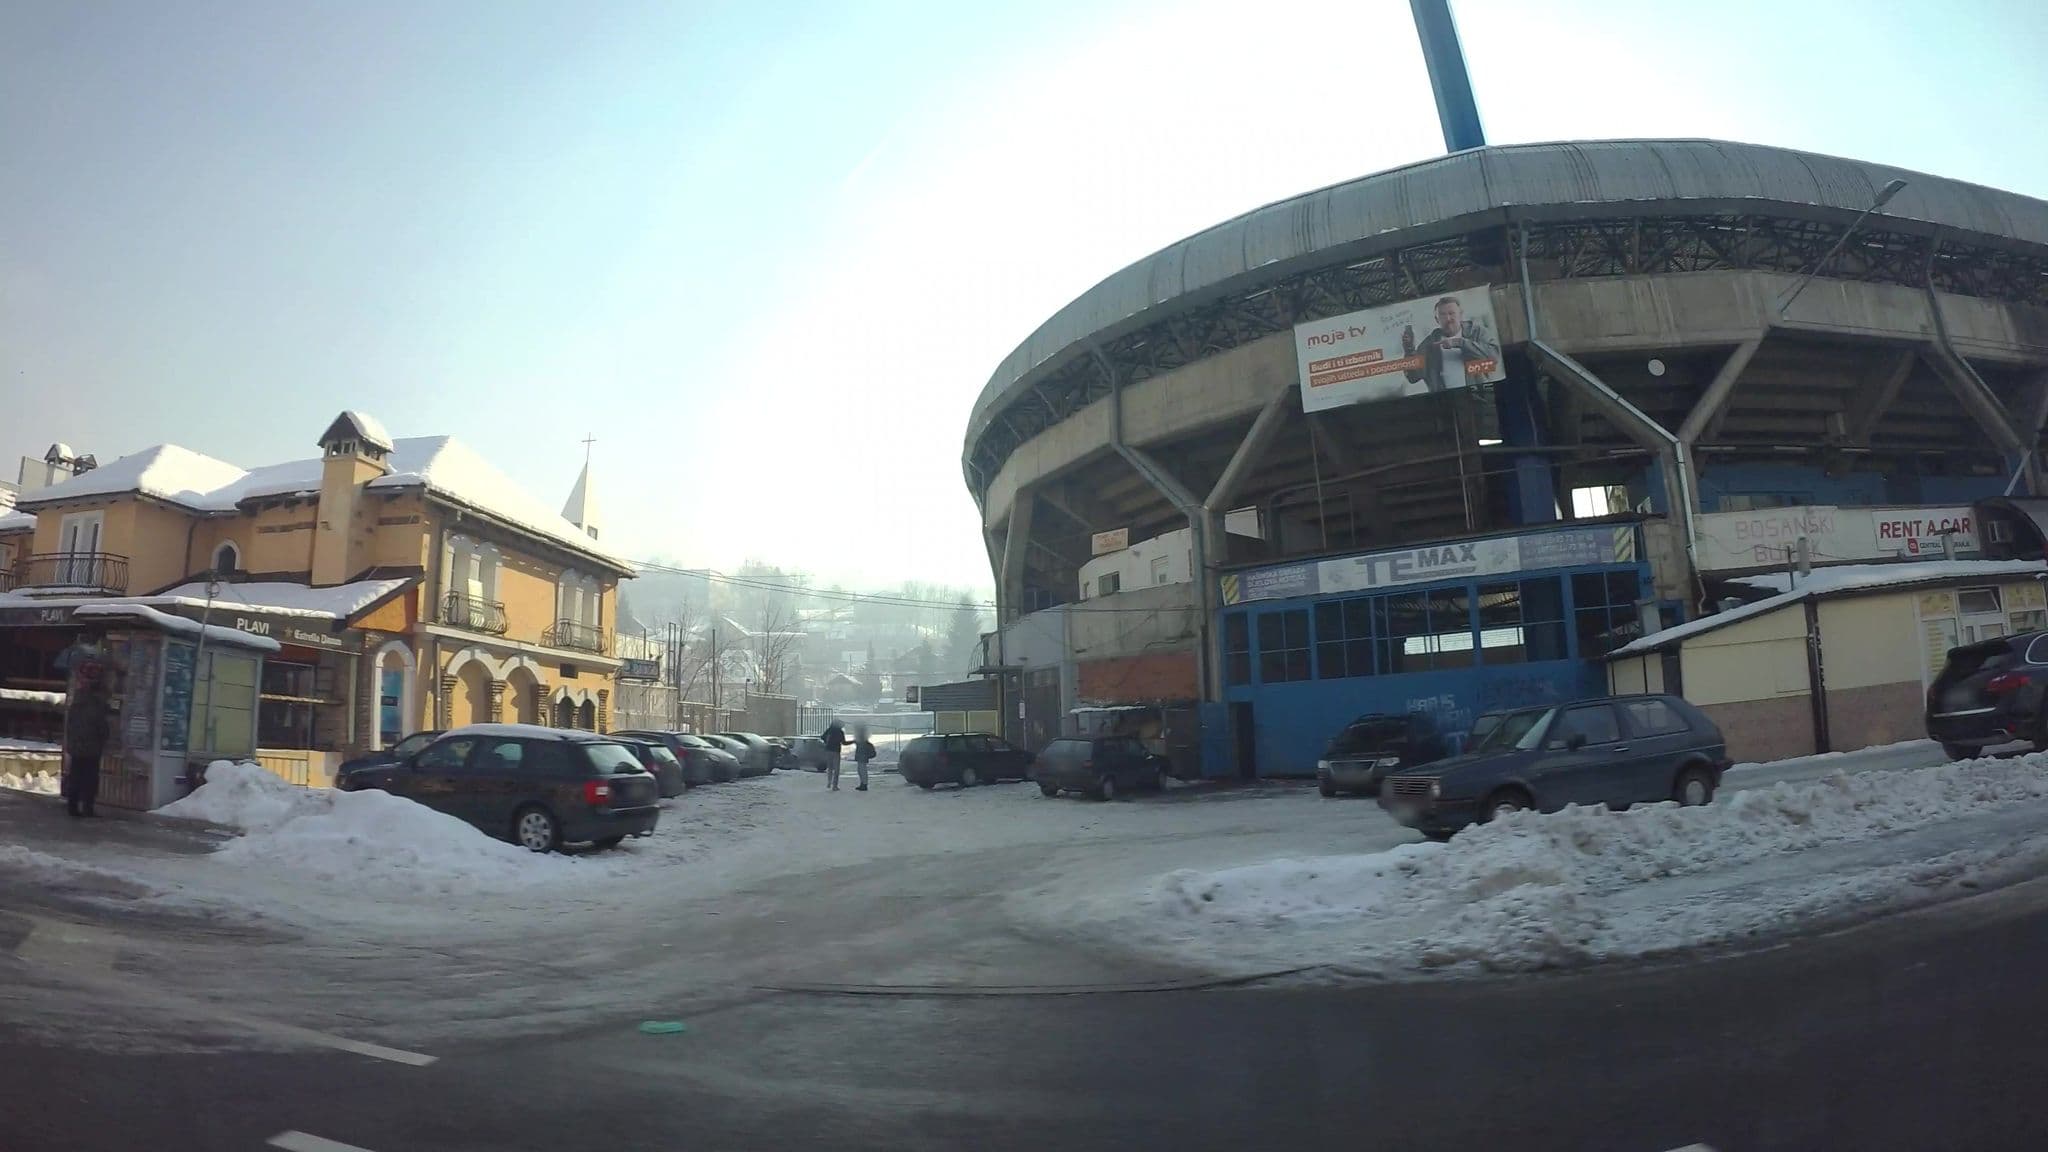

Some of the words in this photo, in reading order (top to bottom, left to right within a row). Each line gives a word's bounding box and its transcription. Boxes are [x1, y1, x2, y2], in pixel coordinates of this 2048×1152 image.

[1307, 329, 1345, 348] moja
[1347, 325, 1367, 339] tv
[1344, 350, 1382, 366] izbornik
[1734, 514, 1834, 541] BOSANSKI
[1879, 520, 1923, 539] RENT
[1926, 519, 1938, 537] A
[1940, 517, 1971, 536] CAR
[236, 617, 270, 635] PLAVI
